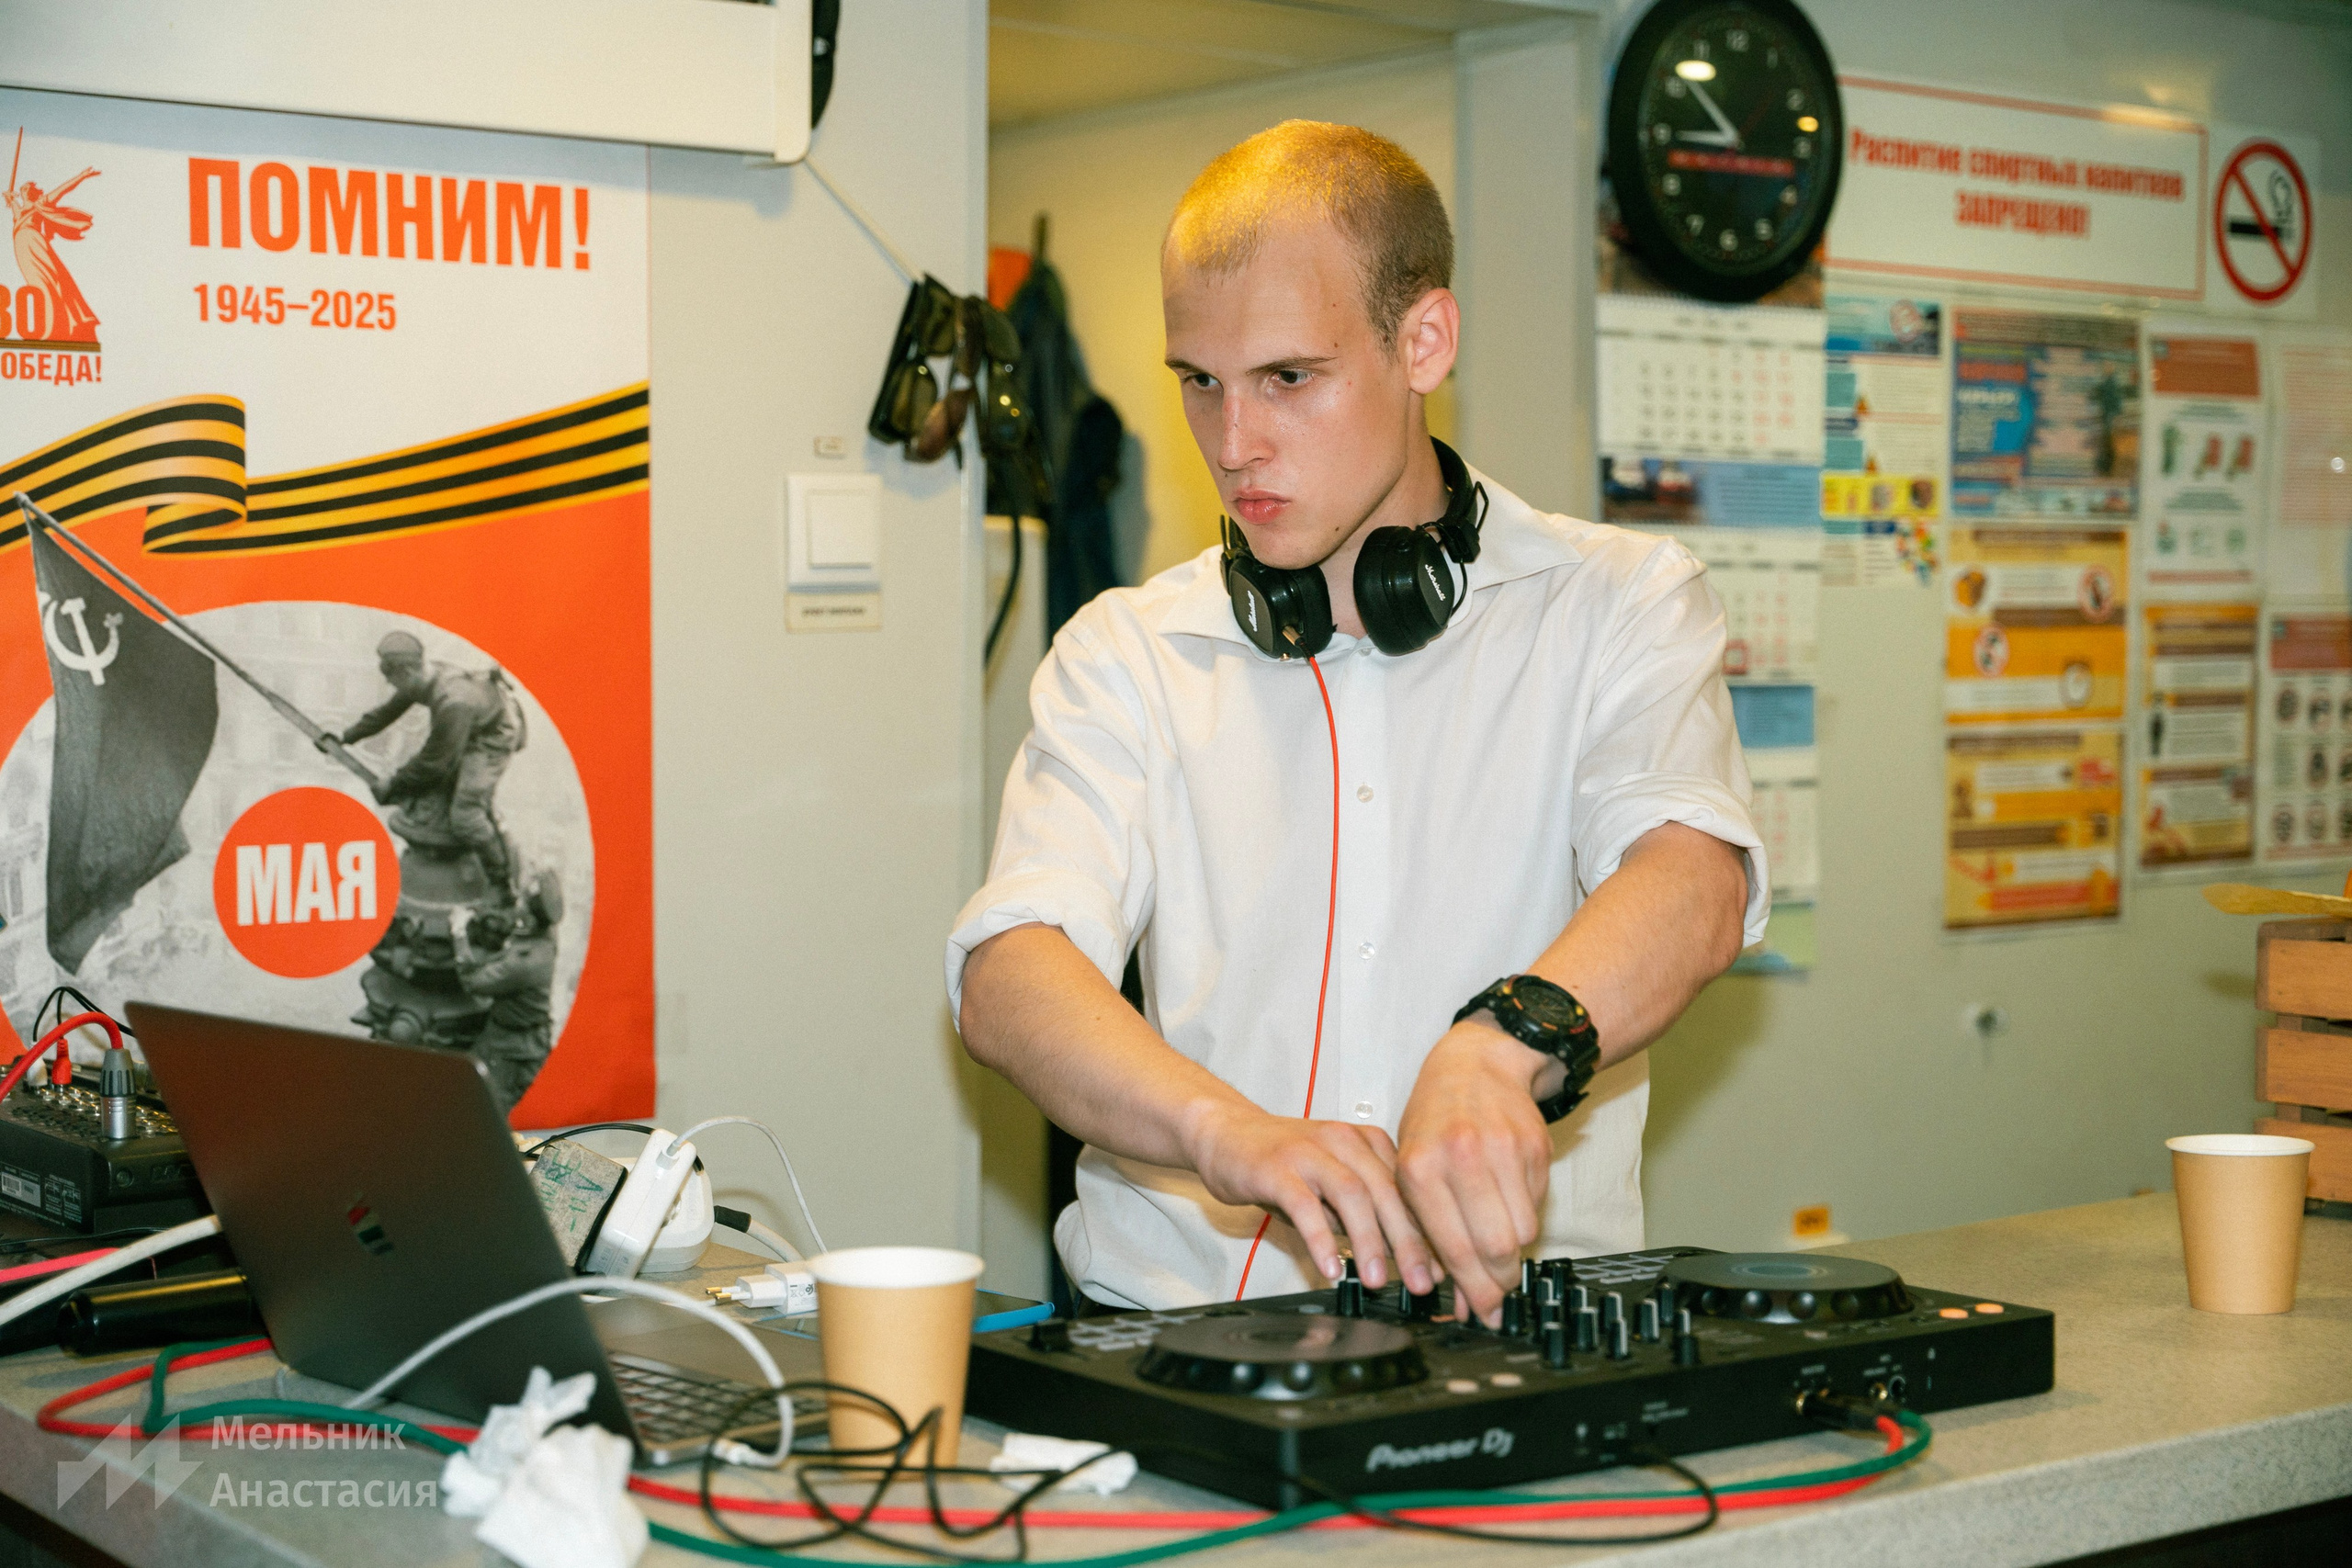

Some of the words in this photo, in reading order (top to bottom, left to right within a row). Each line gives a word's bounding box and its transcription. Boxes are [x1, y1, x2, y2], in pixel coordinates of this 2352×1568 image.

[1849, 129, 1962, 175] Распитие
[187, 157, 590, 270] ПОМНИМ!
[0, 351, 102, 387] ОБЕДА!
[1425, 564, 1446, 602] Marshall
[236, 840, 378, 927] МАЯ
[1365, 1443, 1479, 1472] Pioneer
